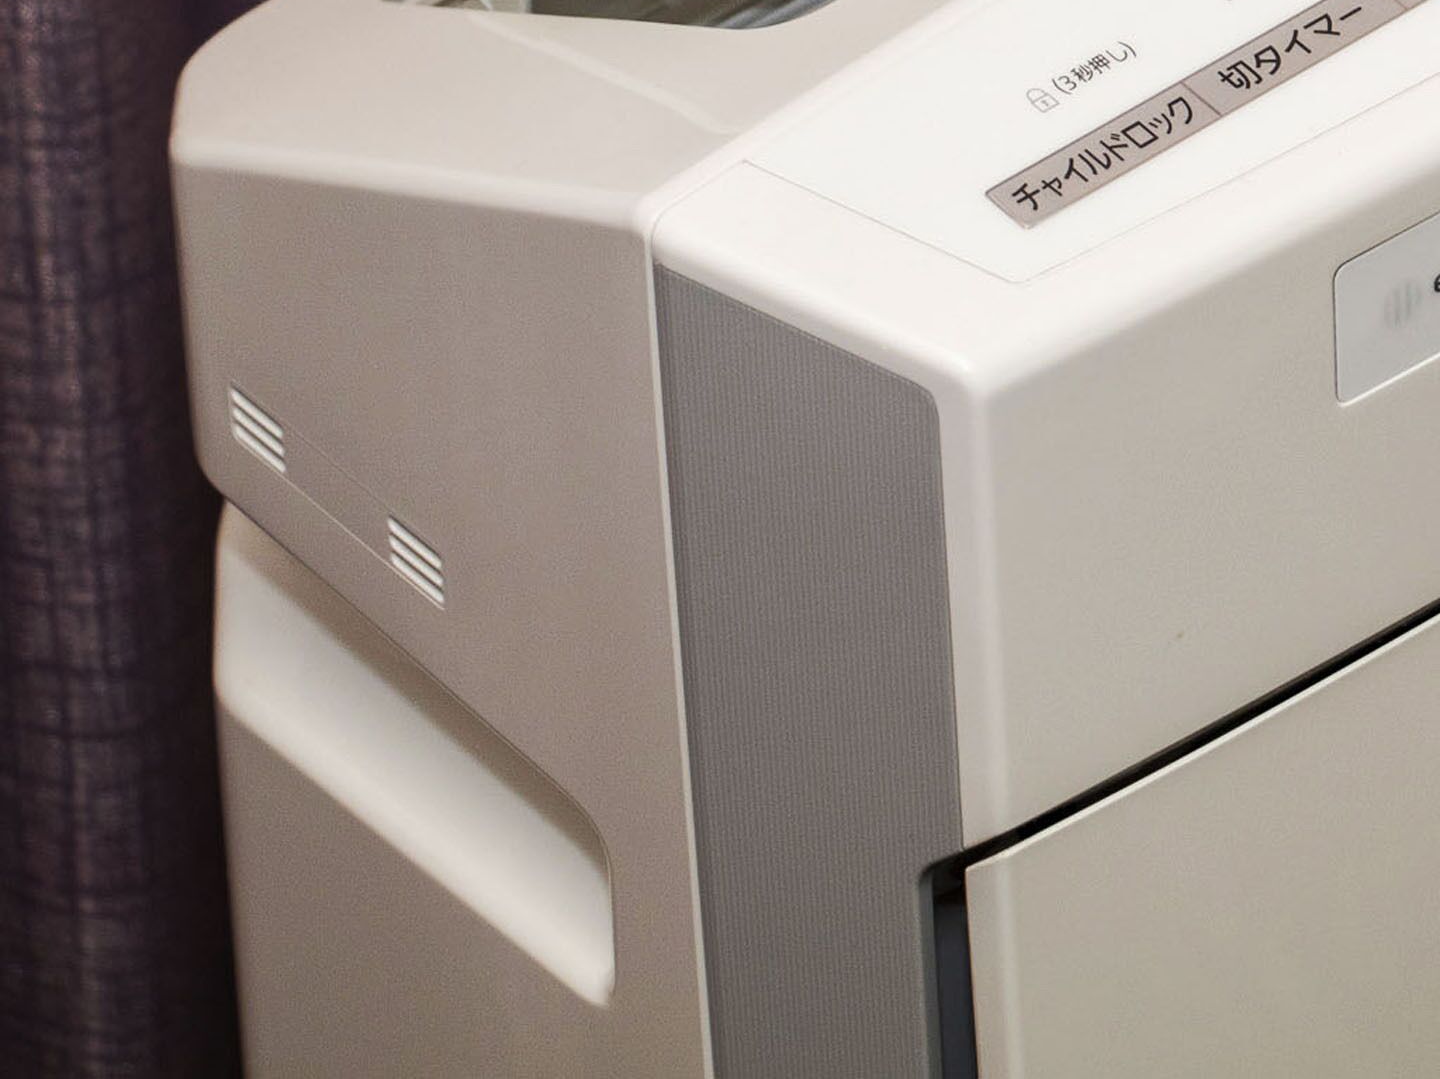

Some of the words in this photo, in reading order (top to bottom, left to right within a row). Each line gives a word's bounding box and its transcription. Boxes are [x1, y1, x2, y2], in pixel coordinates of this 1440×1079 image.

[1051, 40, 1138, 96] (3秒押し)
[1217, 5, 1363, 90] 切タイマー
[1011, 96, 1194, 211] チャイルドロック
